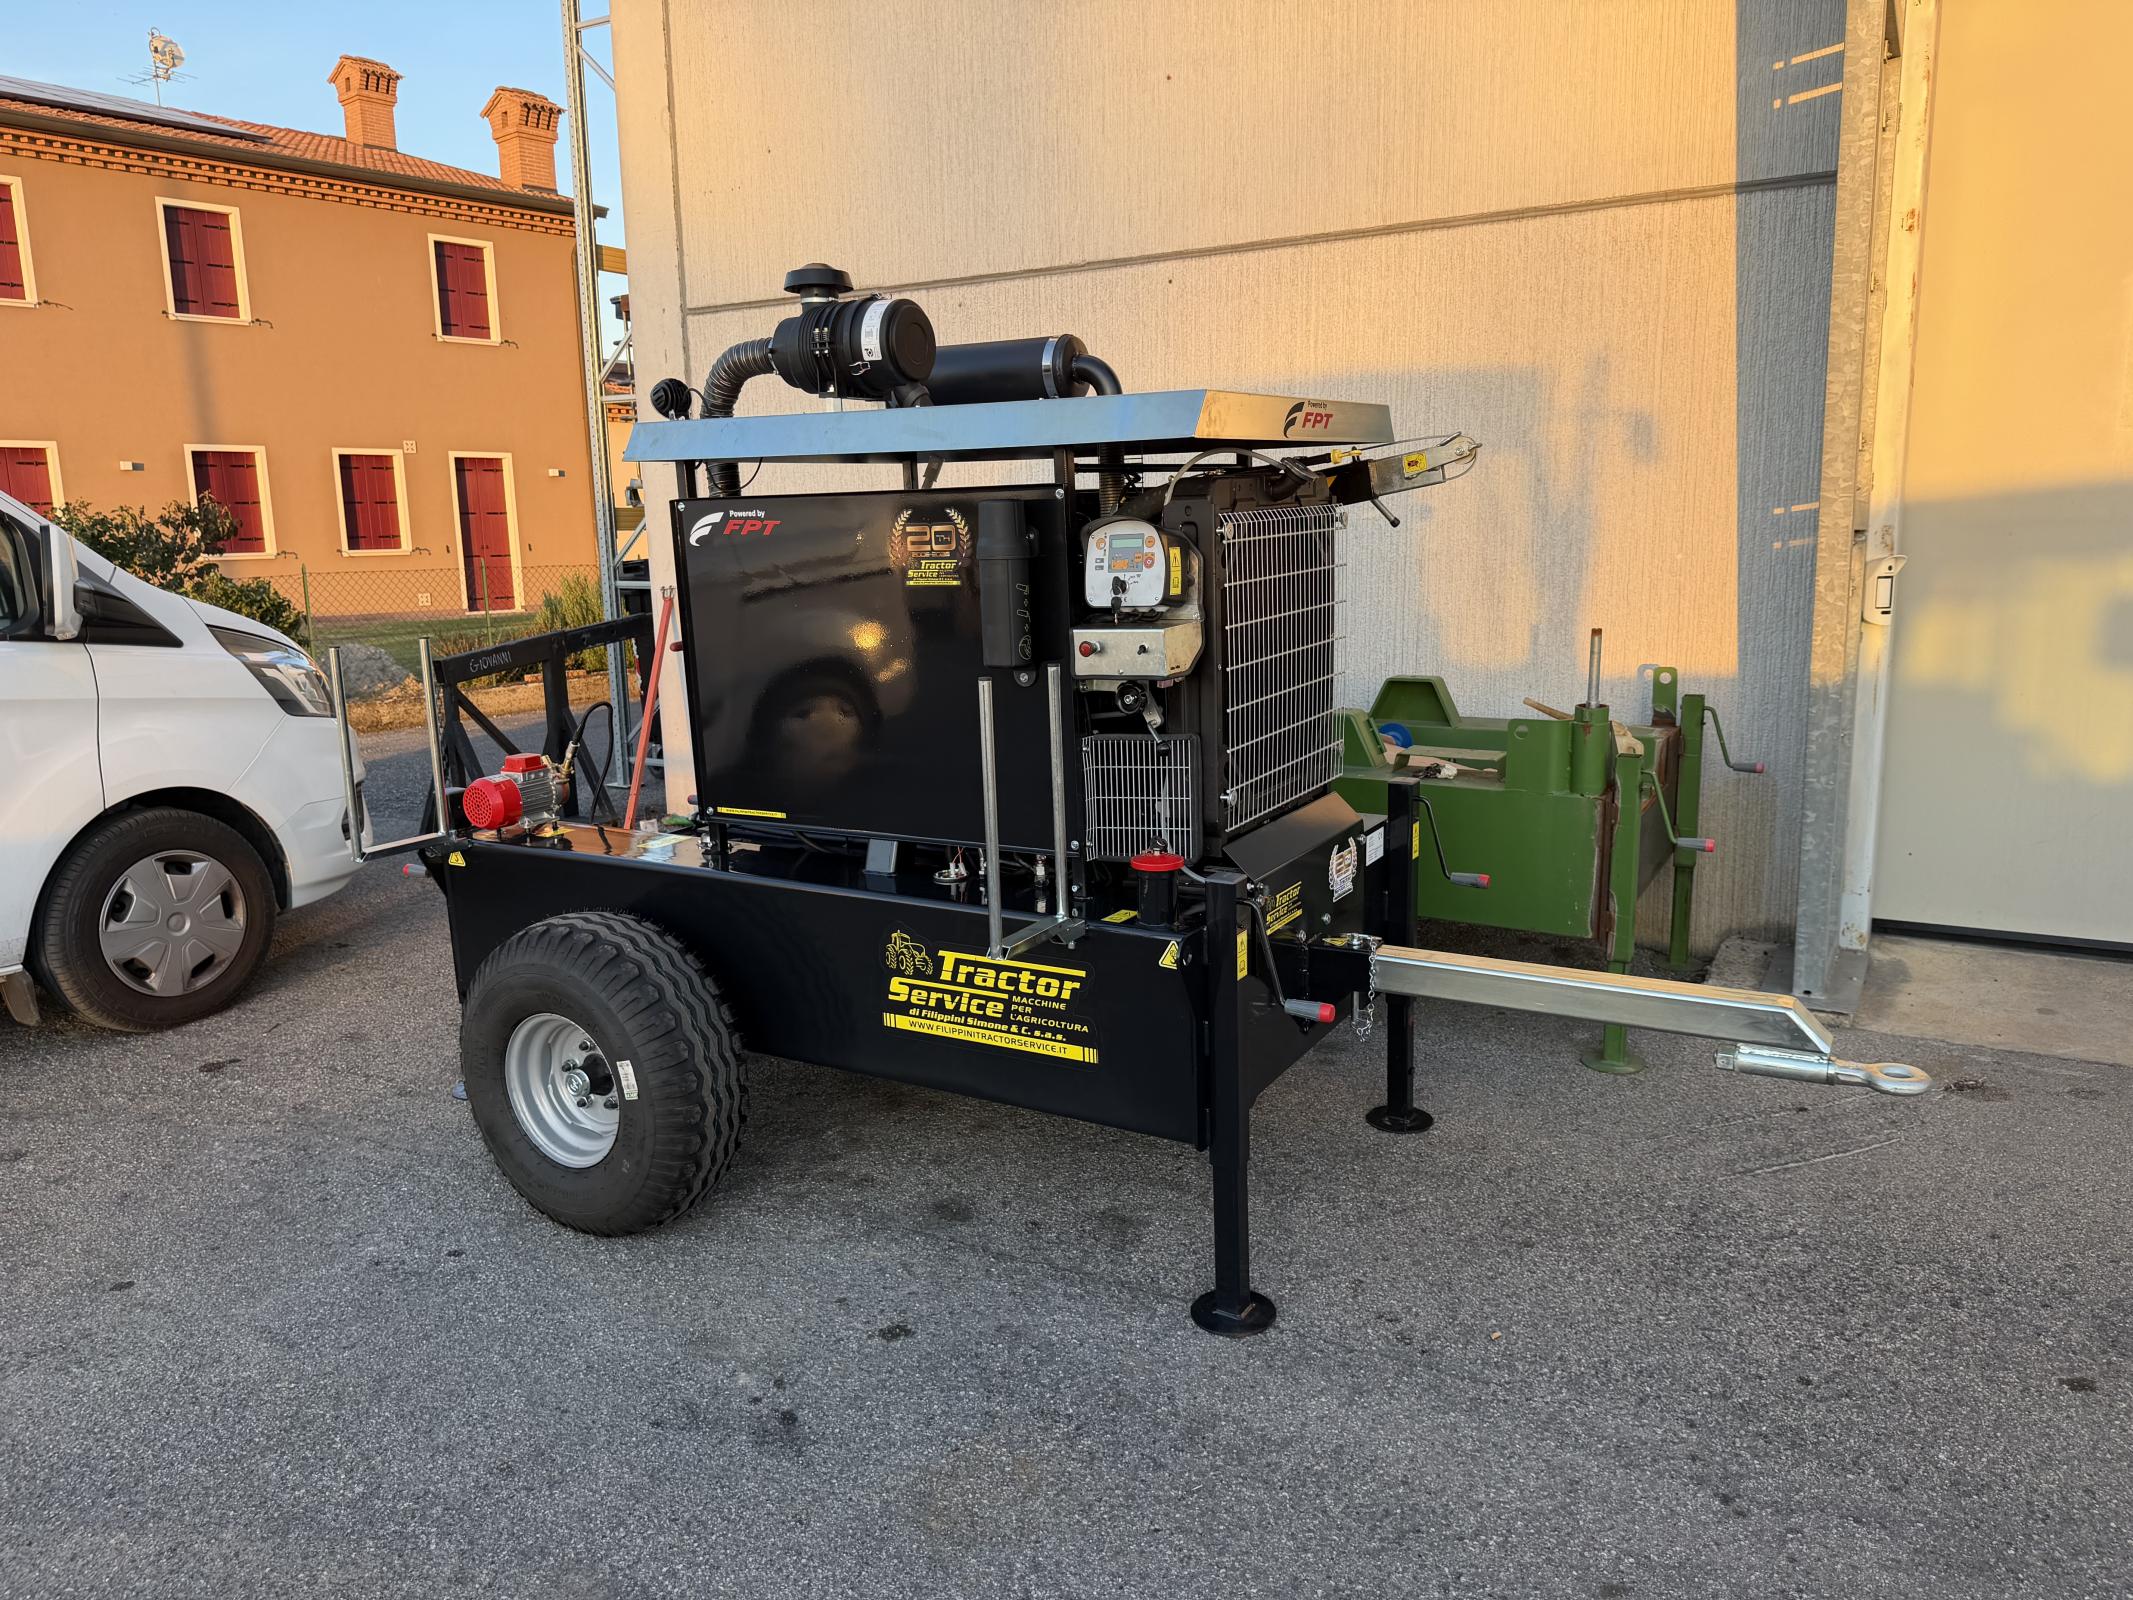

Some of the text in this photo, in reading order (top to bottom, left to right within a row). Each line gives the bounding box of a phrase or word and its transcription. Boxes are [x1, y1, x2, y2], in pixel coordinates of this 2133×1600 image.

[1302, 412, 1333, 429] FPT
[757, 510, 765, 518] by
[723, 520, 781, 535] FPT
[920, 560, 957, 569] Tractor
[470, 651, 511, 672] GIOVANNI
[1276, 881, 1301, 907] Tractor
[938, 950, 1086, 1000] Tractor
[888, 976, 1008, 1018] Service
[1012, 996, 1066, 1010] MACCHINE
[1011, 1004, 1032, 1013] PER
[909, 1008, 920, 1016] di
[921, 1009, 965, 1024] Filippini
[966, 1017, 1008, 1031] Simone
[1010, 1025, 1019, 1033] &
[1021, 1026, 1031, 1035] C.
[1010, 1013, 1089, 1033] L'AGRICOLTURA
[909, 1020, 1068, 1054] WWW.FILIPPINITRACTORSERVICE.IT
